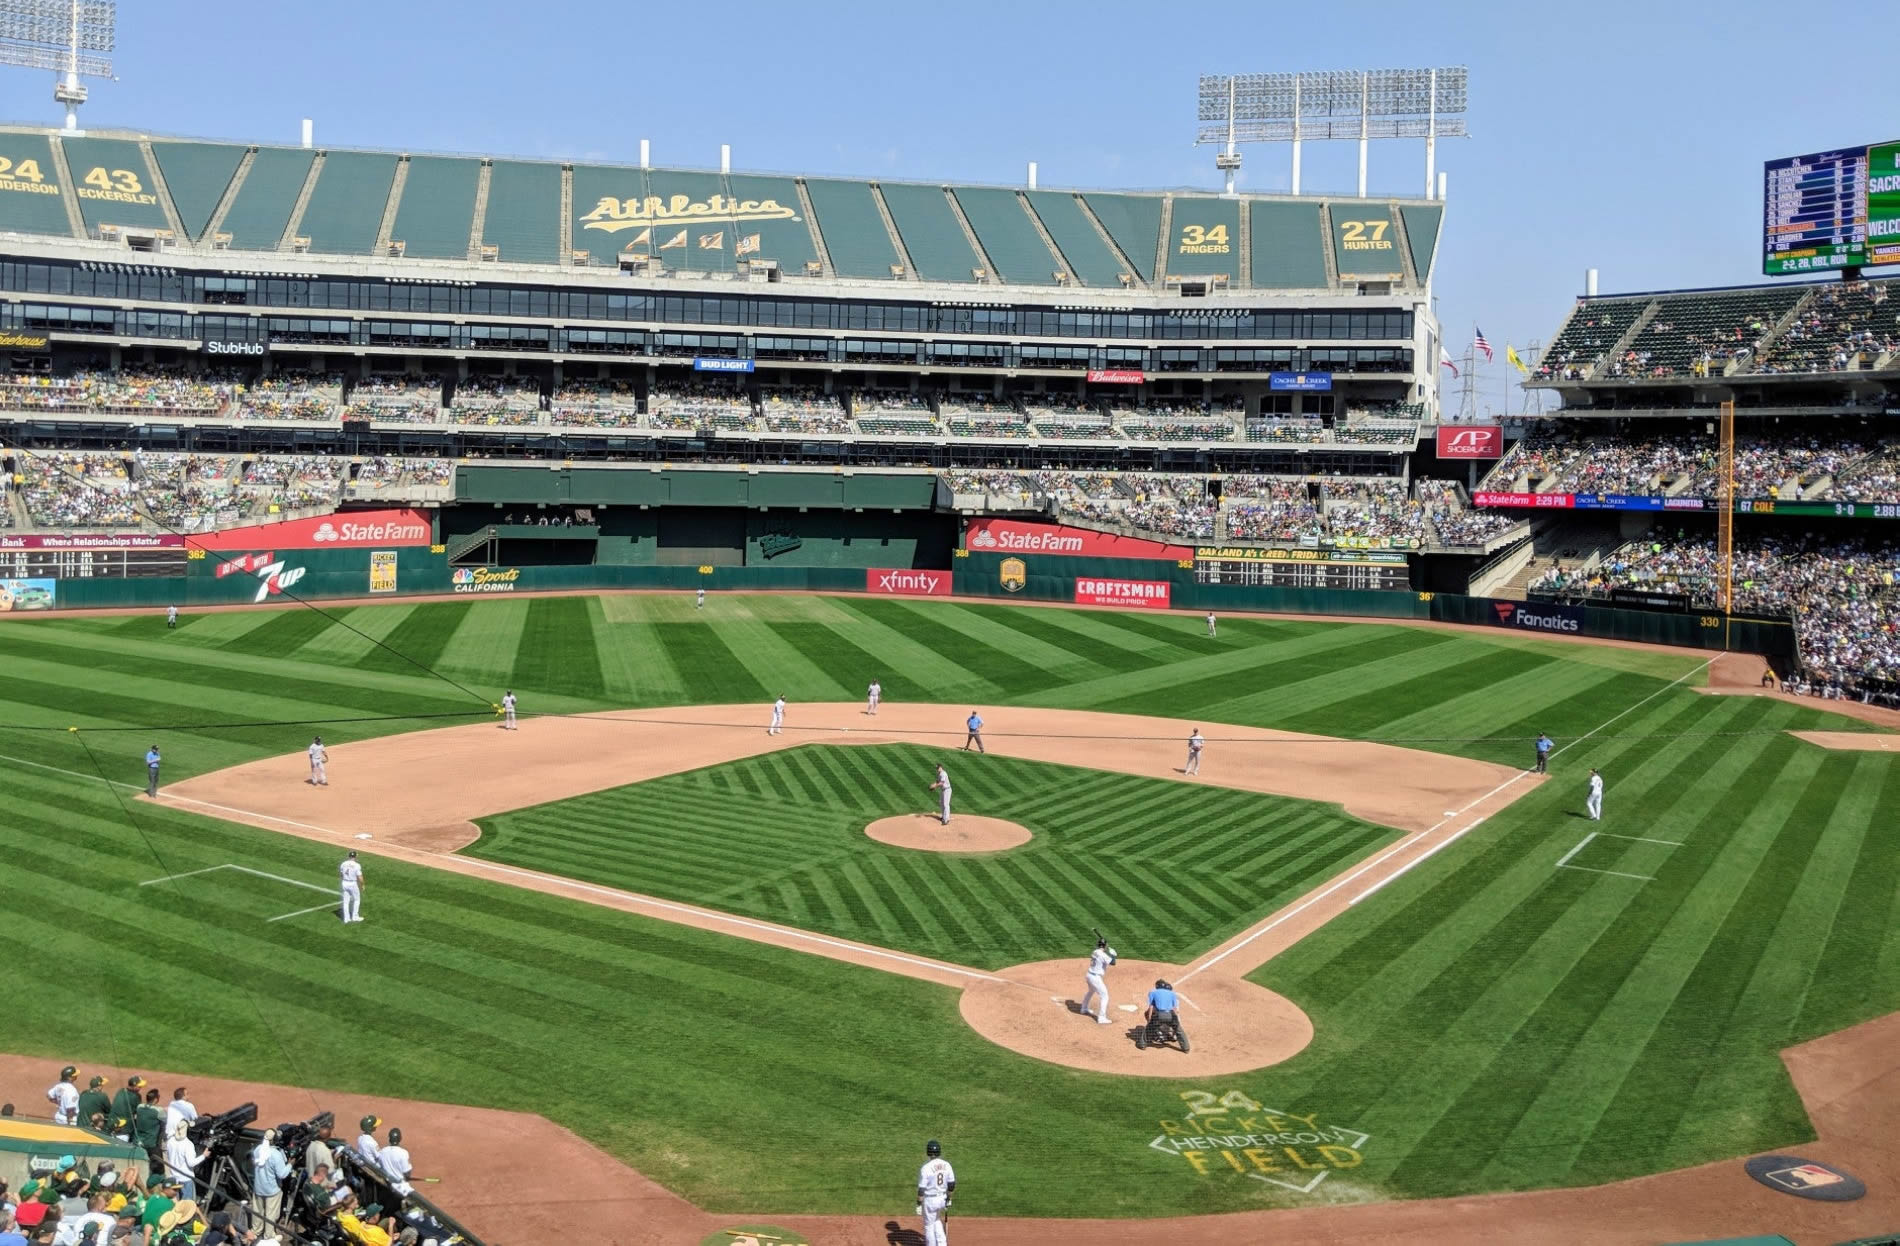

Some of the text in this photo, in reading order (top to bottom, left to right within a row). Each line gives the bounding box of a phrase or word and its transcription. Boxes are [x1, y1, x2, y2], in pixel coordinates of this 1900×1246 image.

[85, 167, 142, 193] 43
[0, 180, 59, 195] DERSON
[78, 187, 157, 205] ECKERSLEY
[579, 194, 796, 226] Athletics
[1182, 224, 1229, 245] 34
[1341, 220, 1389, 241] 27
[1180, 244, 1229, 254] FINGERS
[1343, 240, 1392, 250] HUNTER
[208, 341, 264, 355] StubHub
[701, 360, 748, 369] BUD LIGHT
[1092, 371, 1140, 383] Budweiser
[1536, 495, 1553, 506] 2:29
[1554, 496, 1567, 506] PM
[1740, 501, 1751, 511] 67
[1754, 501, 1775, 512] COLE
[1874, 505, 1895, 516] 2.88
[2, 537, 162, 548] Bank Where Relationships Matter
[188, 550, 206, 559] 362
[1197, 547, 1243, 558] OAKLAND
[1291, 550, 1330, 560] FRIDAYS
[473, 567, 520, 585] Sports
[699, 566, 713, 574] 400
[454, 583, 514, 593] CALIFORNIA
[879, 570, 939, 594] xfinity
[1077, 581, 1166, 598] CRAFTSMAN
[1516, 609, 1578, 631] Fanatics
[1701, 616, 1719, 627] 330
[1180, 1090, 1263, 1115] 24
[1160, 1113, 1318, 1136] RICKEY
[1170, 1129, 1345, 1150] HENDERSON
[1183, 1145, 1363, 1176] FIELD
[937, 1172, 944, 1186] 8
